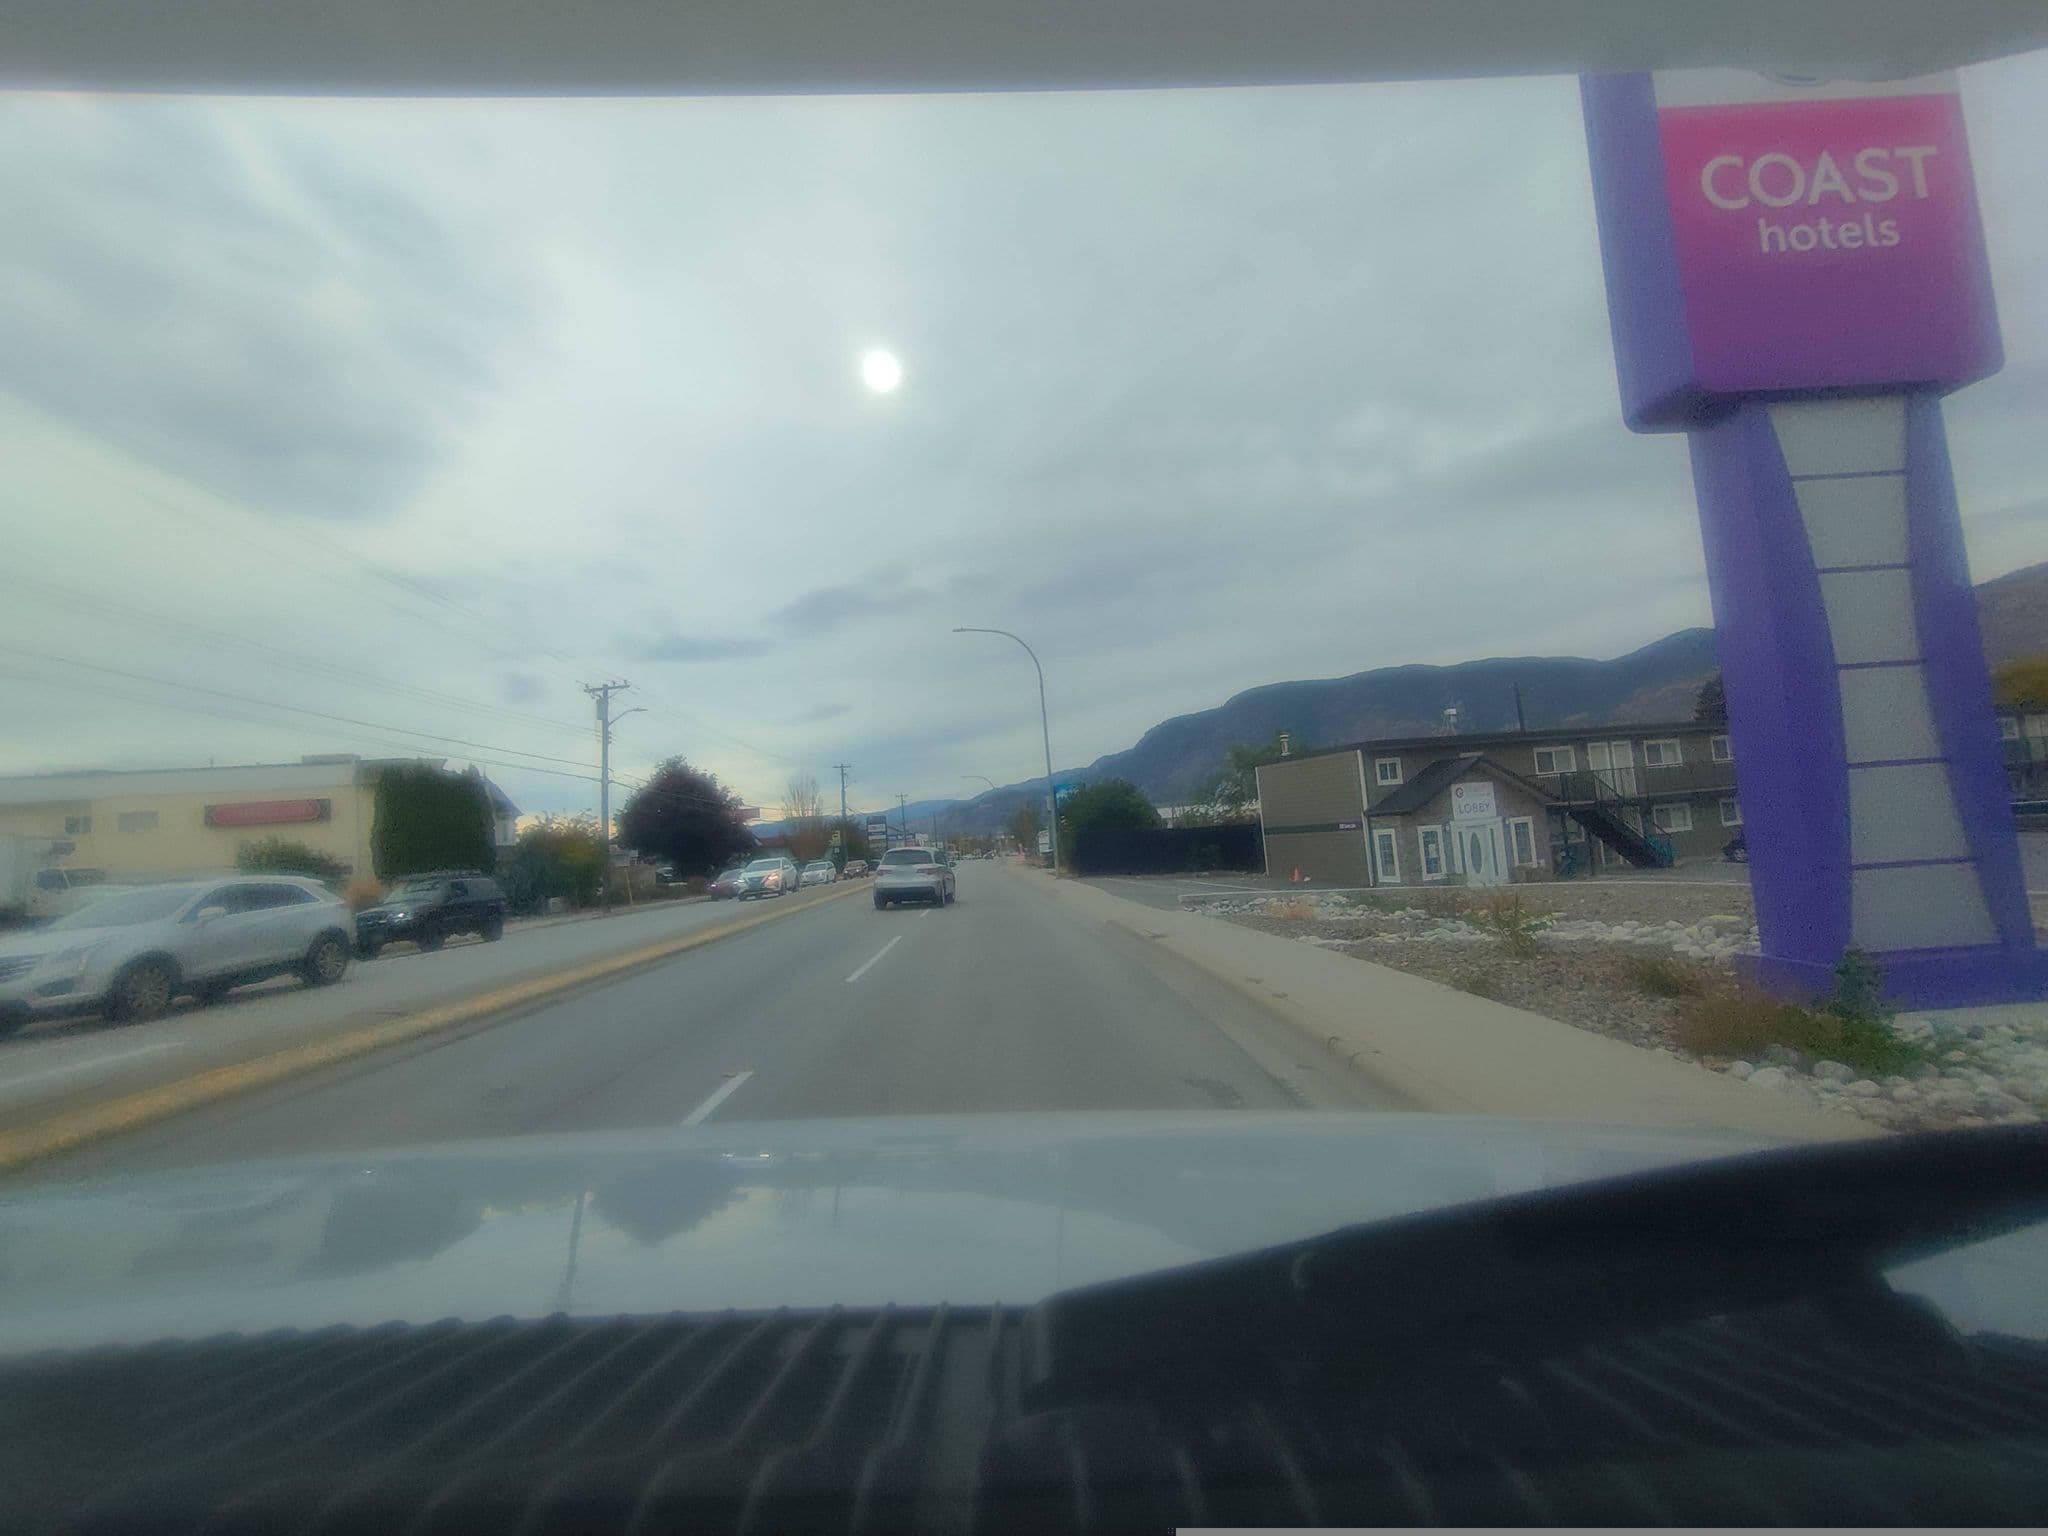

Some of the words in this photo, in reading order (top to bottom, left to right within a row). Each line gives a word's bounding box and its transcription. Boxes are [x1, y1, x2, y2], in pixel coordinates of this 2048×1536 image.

[1701, 145, 1938, 210] COAST
[1758, 213, 1901, 253] hotels
[1458, 801, 1490, 814] LOBBY
